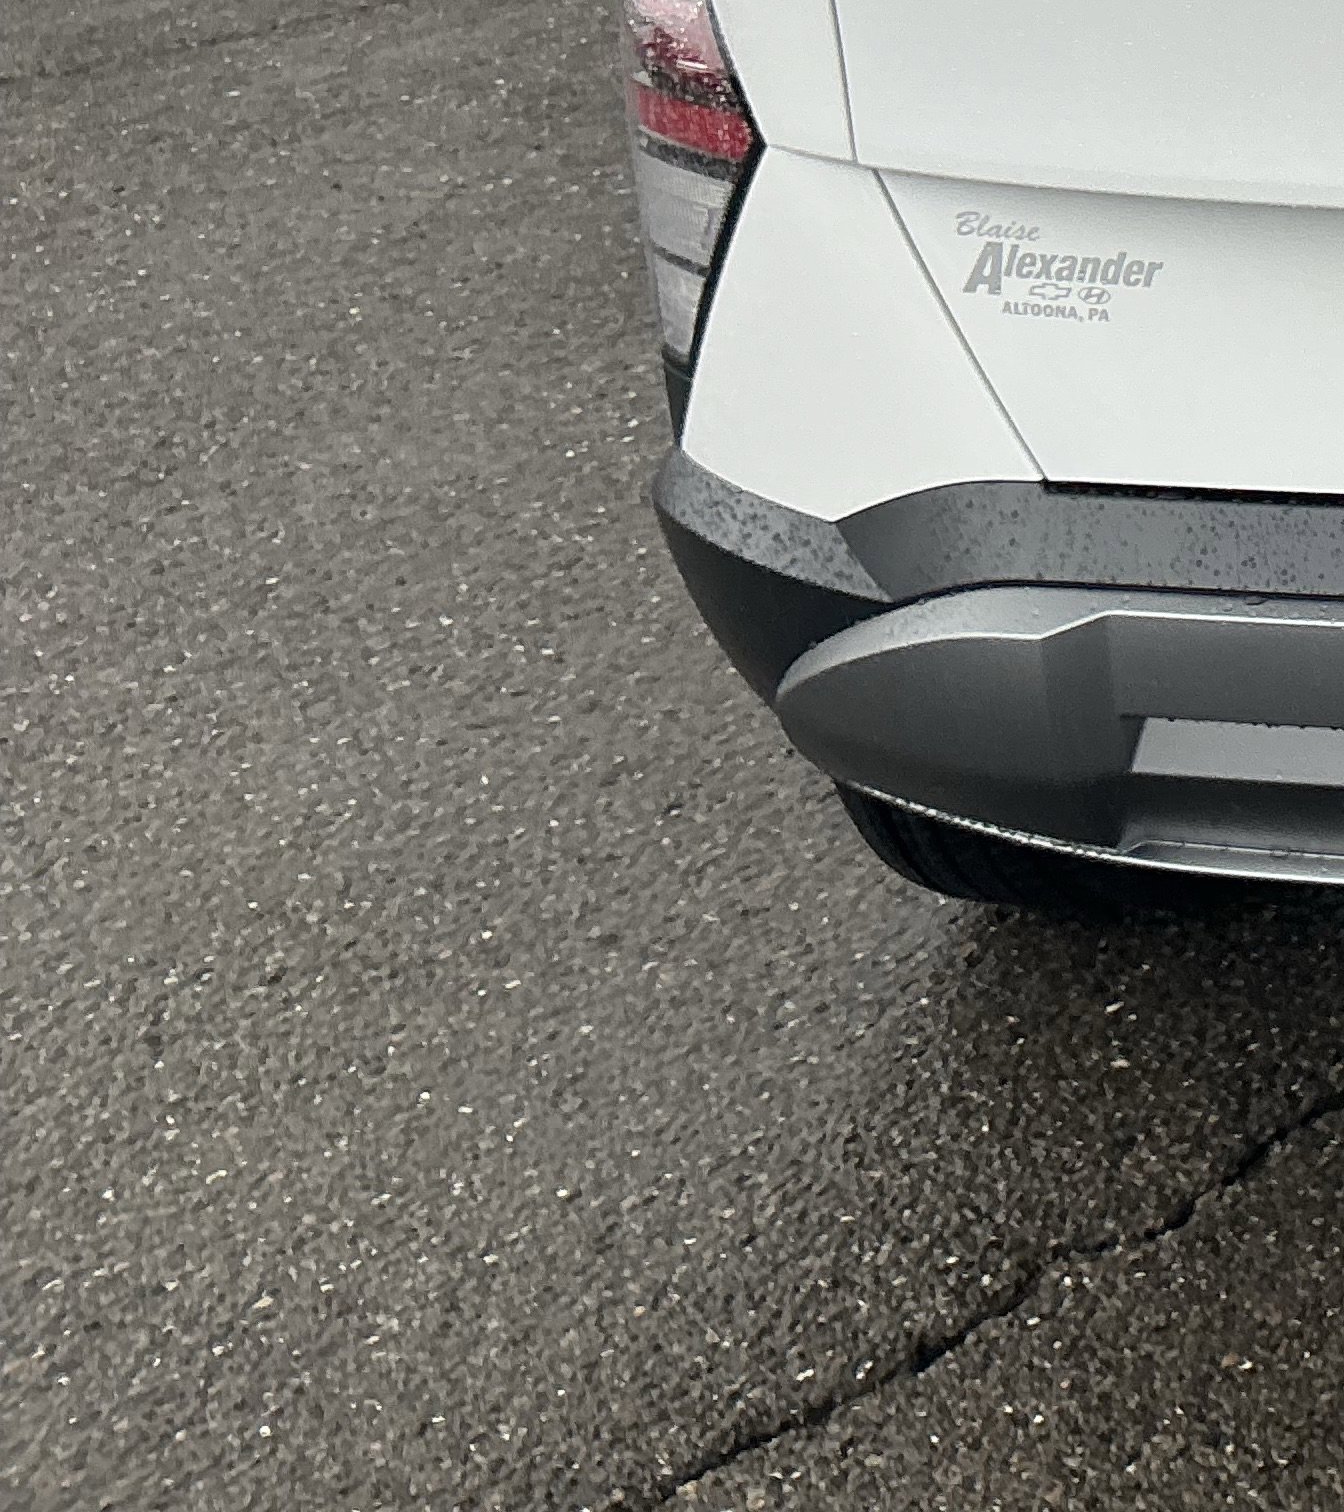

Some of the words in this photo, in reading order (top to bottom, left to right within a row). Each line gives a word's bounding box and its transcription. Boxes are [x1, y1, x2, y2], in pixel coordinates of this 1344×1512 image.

[955, 211, 1041, 241] Blaise
[962, 241, 1164, 295] Alexander
[1002, 302, 1084, 322] ALTOONA,
[1087, 307, 1111, 322] PA
